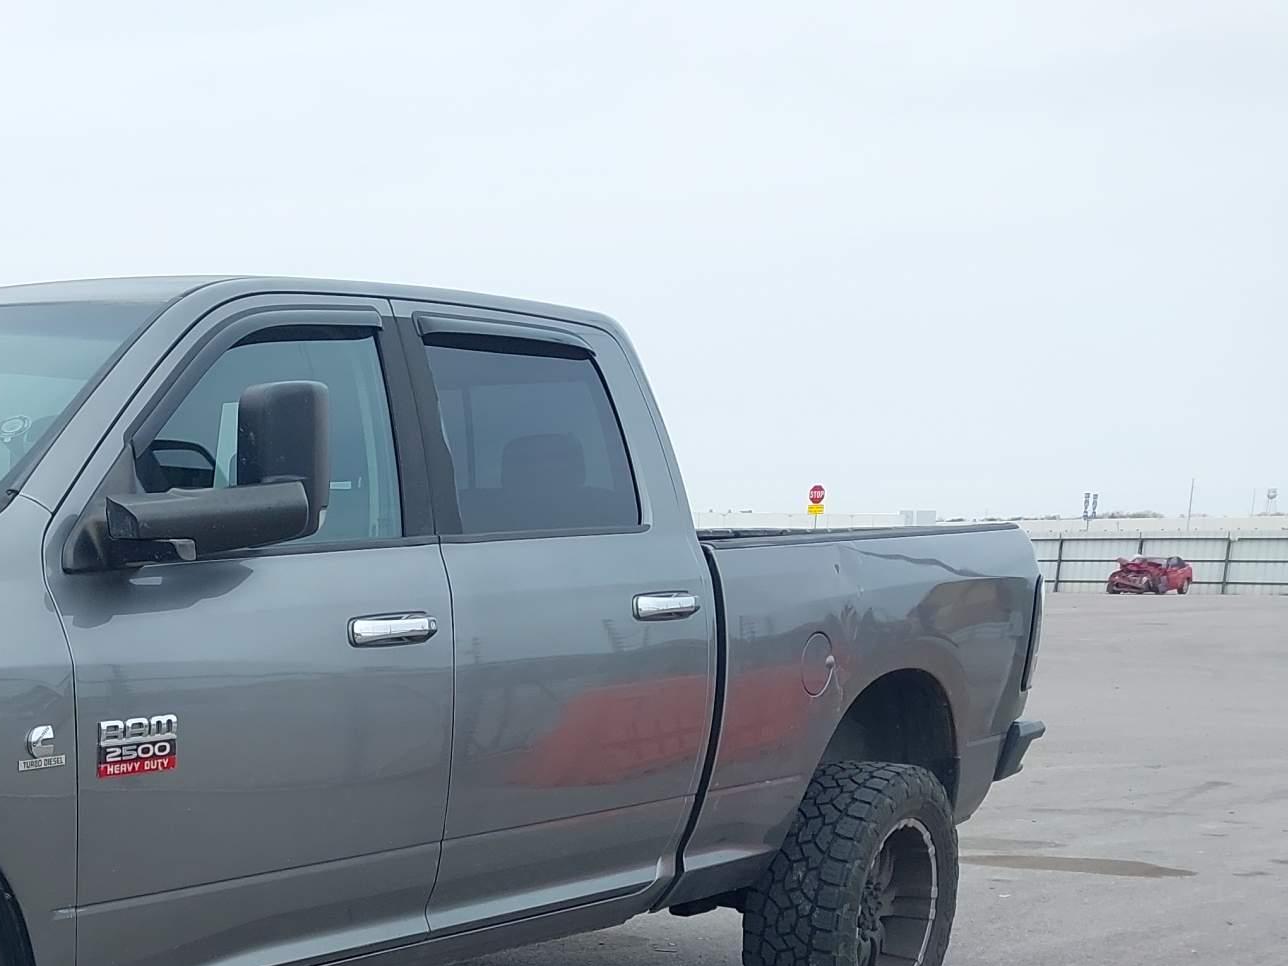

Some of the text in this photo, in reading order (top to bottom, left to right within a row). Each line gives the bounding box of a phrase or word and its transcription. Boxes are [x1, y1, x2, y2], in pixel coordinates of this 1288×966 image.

[100, 714, 177, 744] RAM
[106, 742, 170, 762] 2500
[22, 756, 64, 769] TURBO DIESEL
[107, 759, 170, 775] HEAVY DUTY
